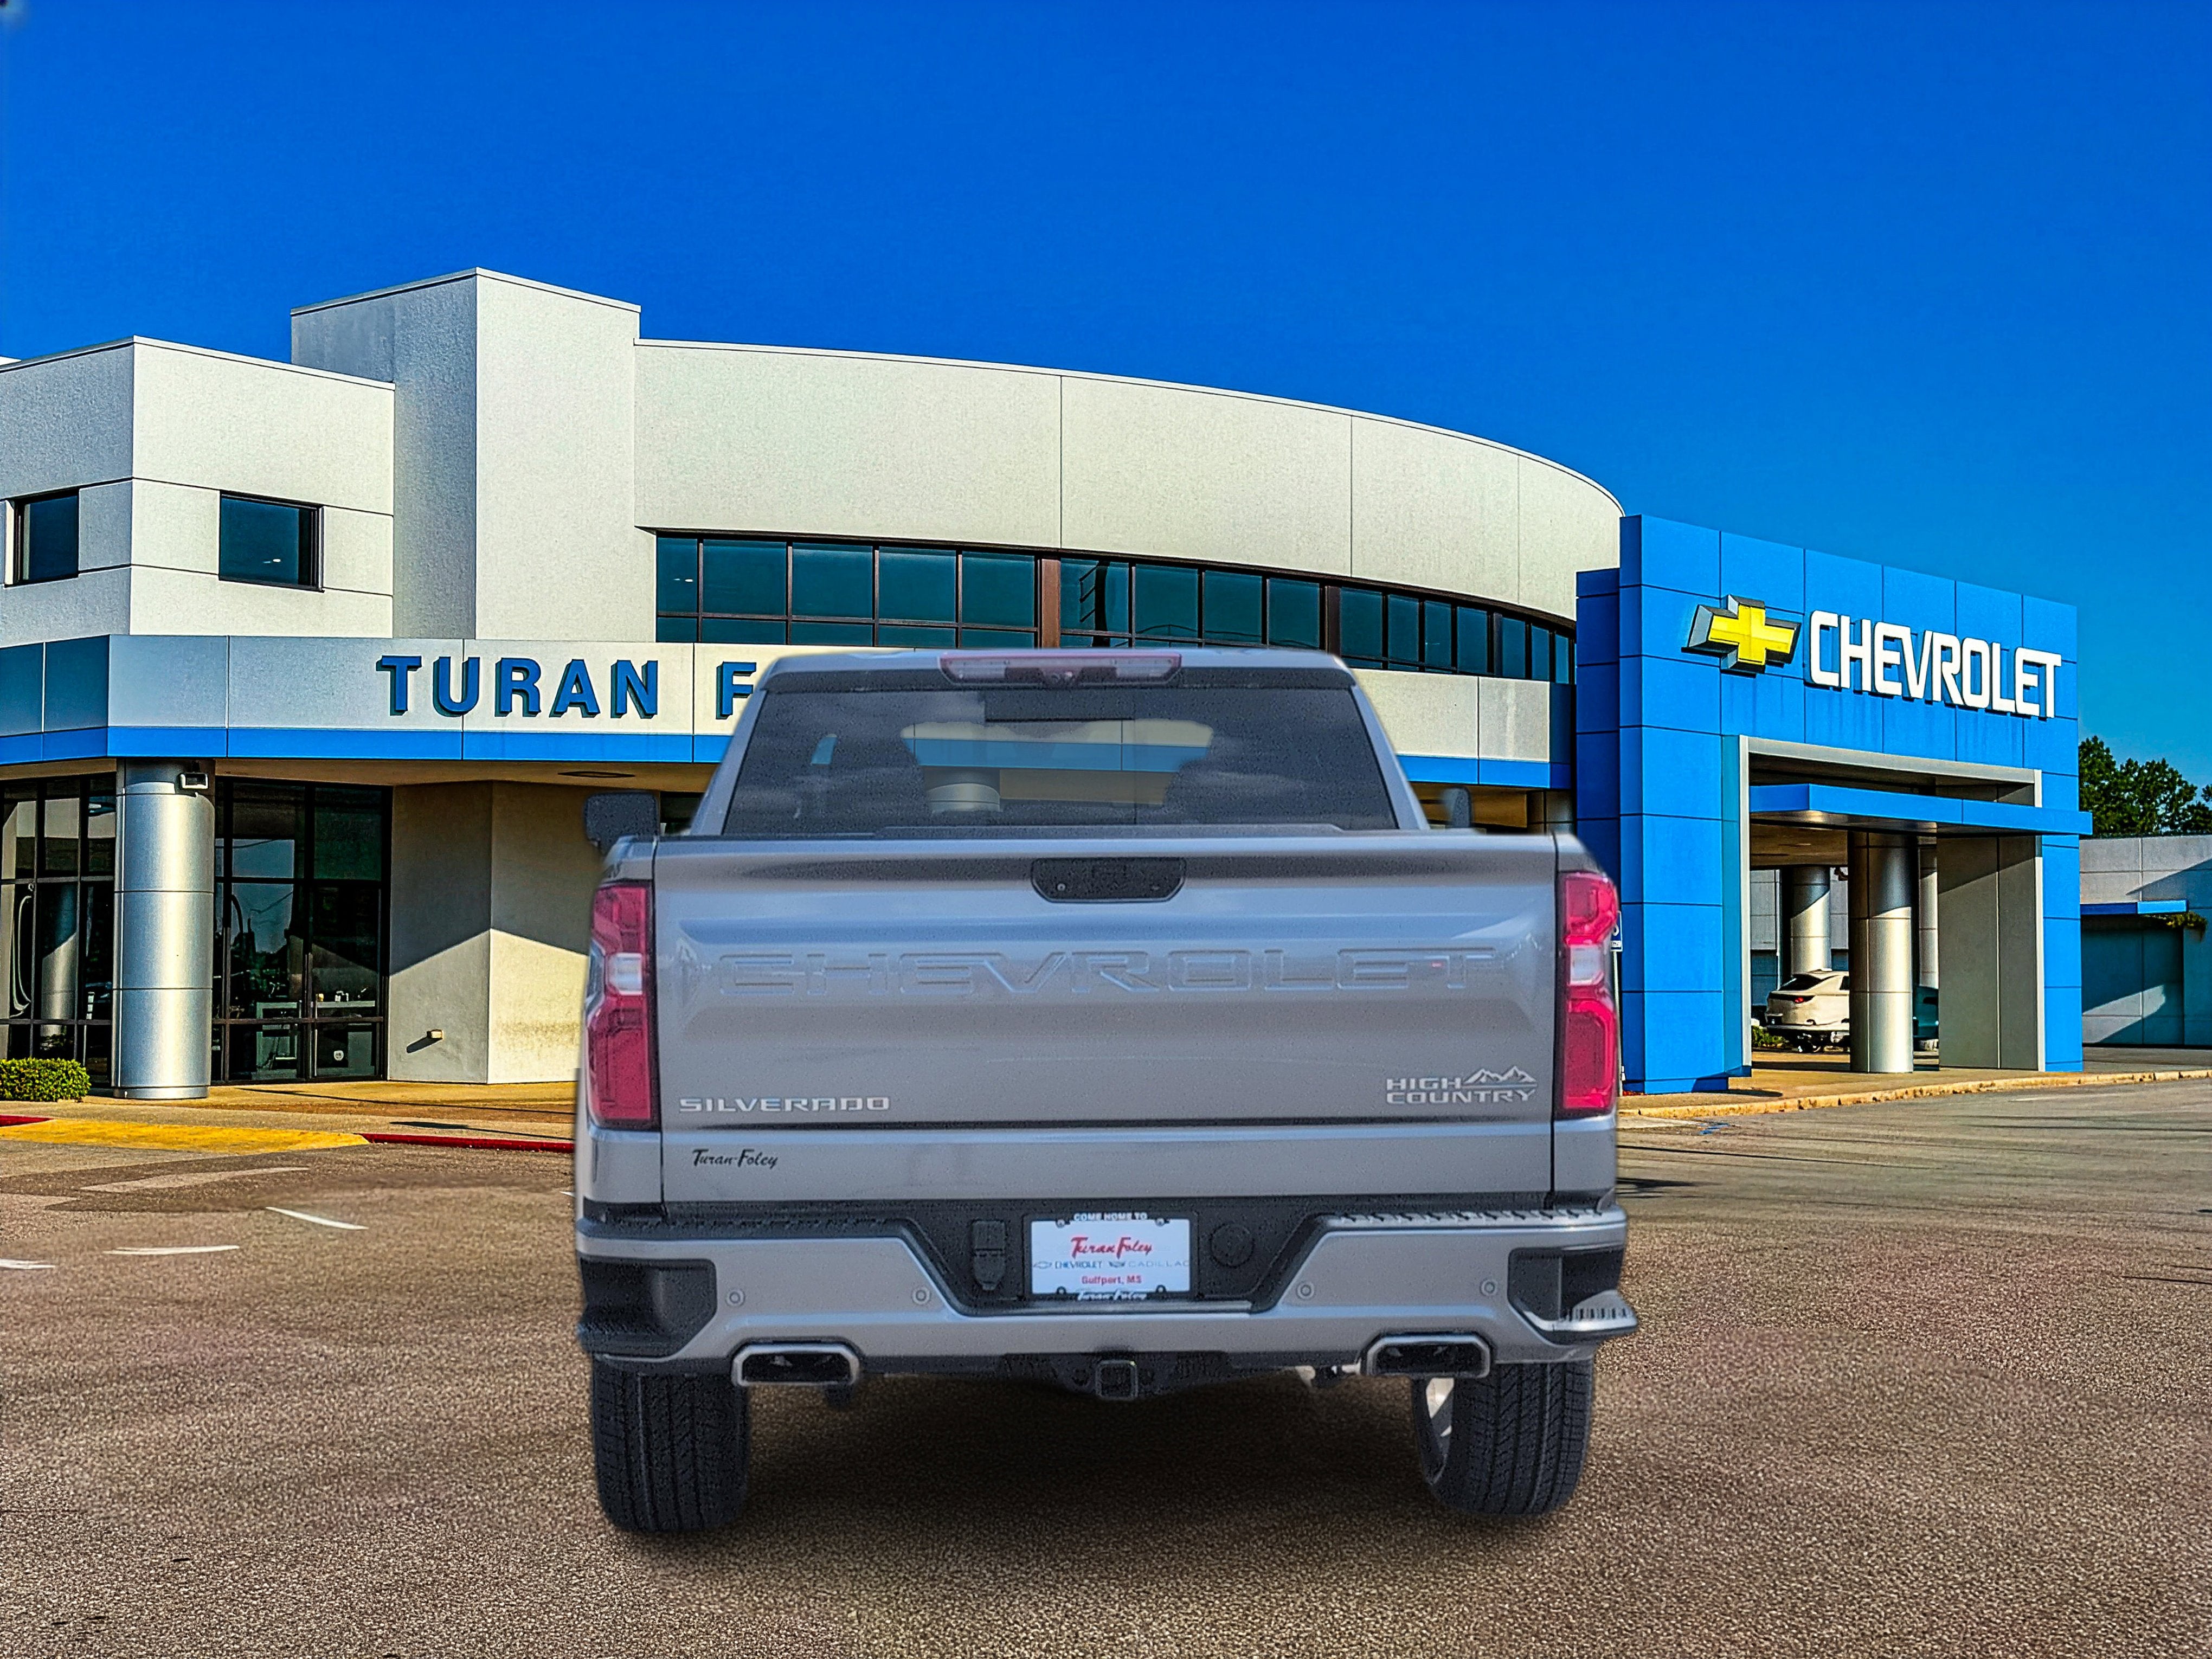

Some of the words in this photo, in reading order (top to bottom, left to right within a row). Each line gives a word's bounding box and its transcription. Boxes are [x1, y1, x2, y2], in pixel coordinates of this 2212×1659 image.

[1810, 610, 2062, 718] CHEVROLET
[376, 655, 658, 719] TURAN
[716, 661, 757, 720] F
[719, 946, 1496, 995] CHEVROLET
[1386, 1077, 1461, 1091] HIGH
[1386, 1089, 1536, 1104] COUNTRY
[679, 1096, 890, 1113] SILVERADO
[1073, 1212, 1101, 1220] COME
[1104, 1212, 1131, 1220] HOME
[1134, 1212, 1148, 1220] TO
[1054, 1261, 1102, 1269] CHEVROLET
[1128, 1259, 1189, 1268] CADILLAC
[1126, 1274, 1142, 1284] MS
